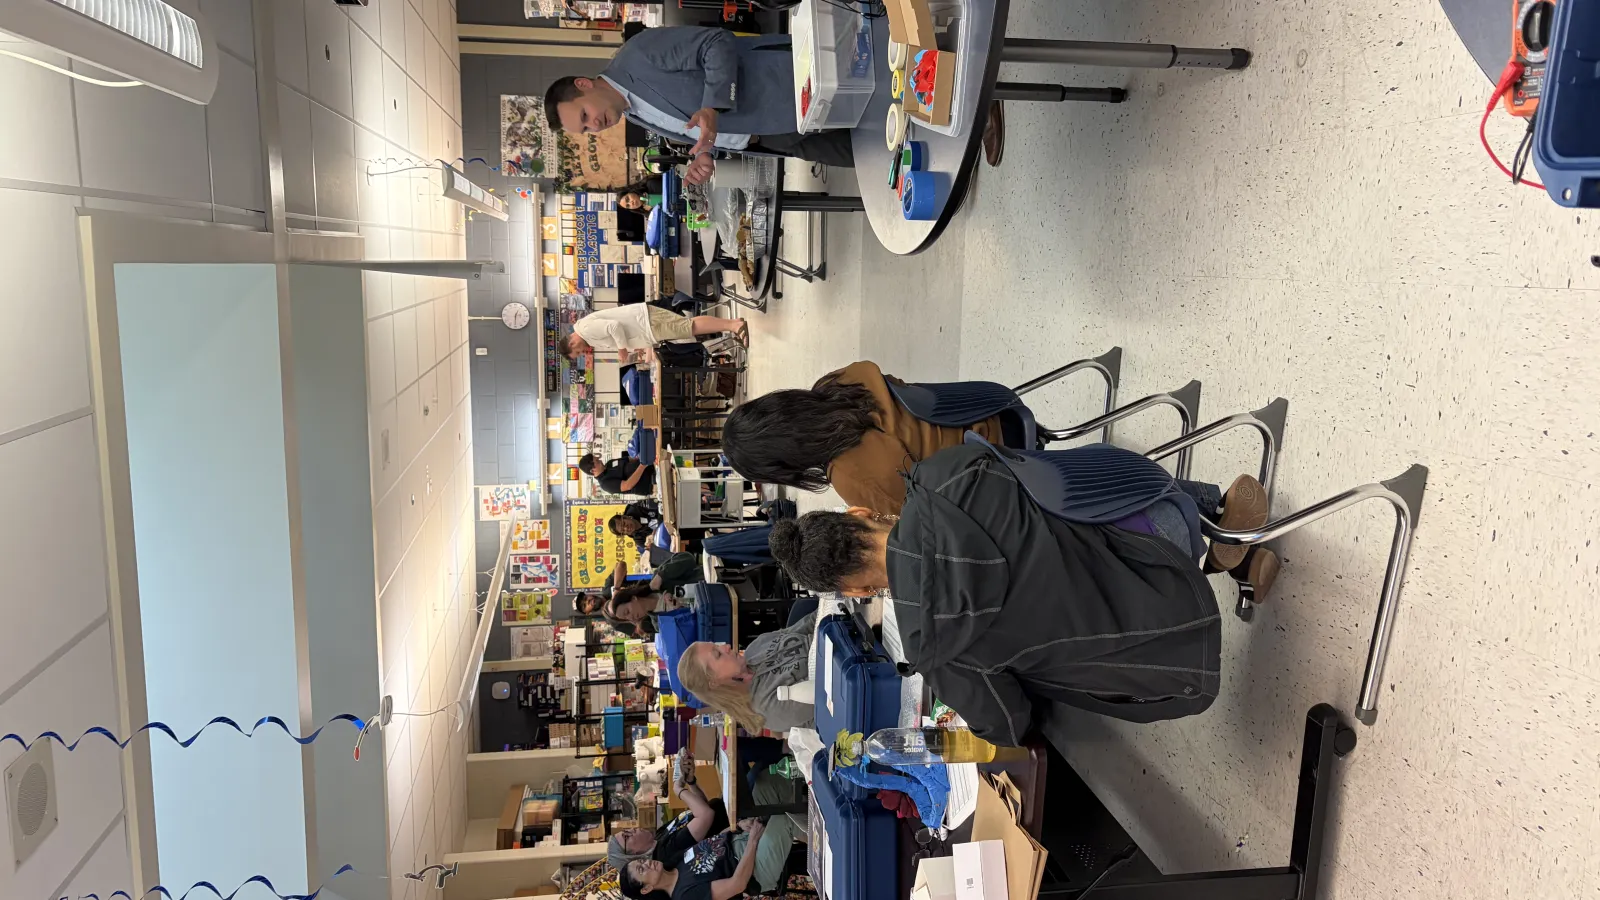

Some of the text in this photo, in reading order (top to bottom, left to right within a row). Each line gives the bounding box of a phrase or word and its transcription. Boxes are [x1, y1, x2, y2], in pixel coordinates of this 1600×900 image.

[588, 133, 600, 172] GROW
[586, 214, 598, 263] PLASTIC
[546, 330, 555, 370] POSSIBLE
[578, 508, 590, 584] GREAT MINDS
[594, 518, 606, 574] QUESTION
